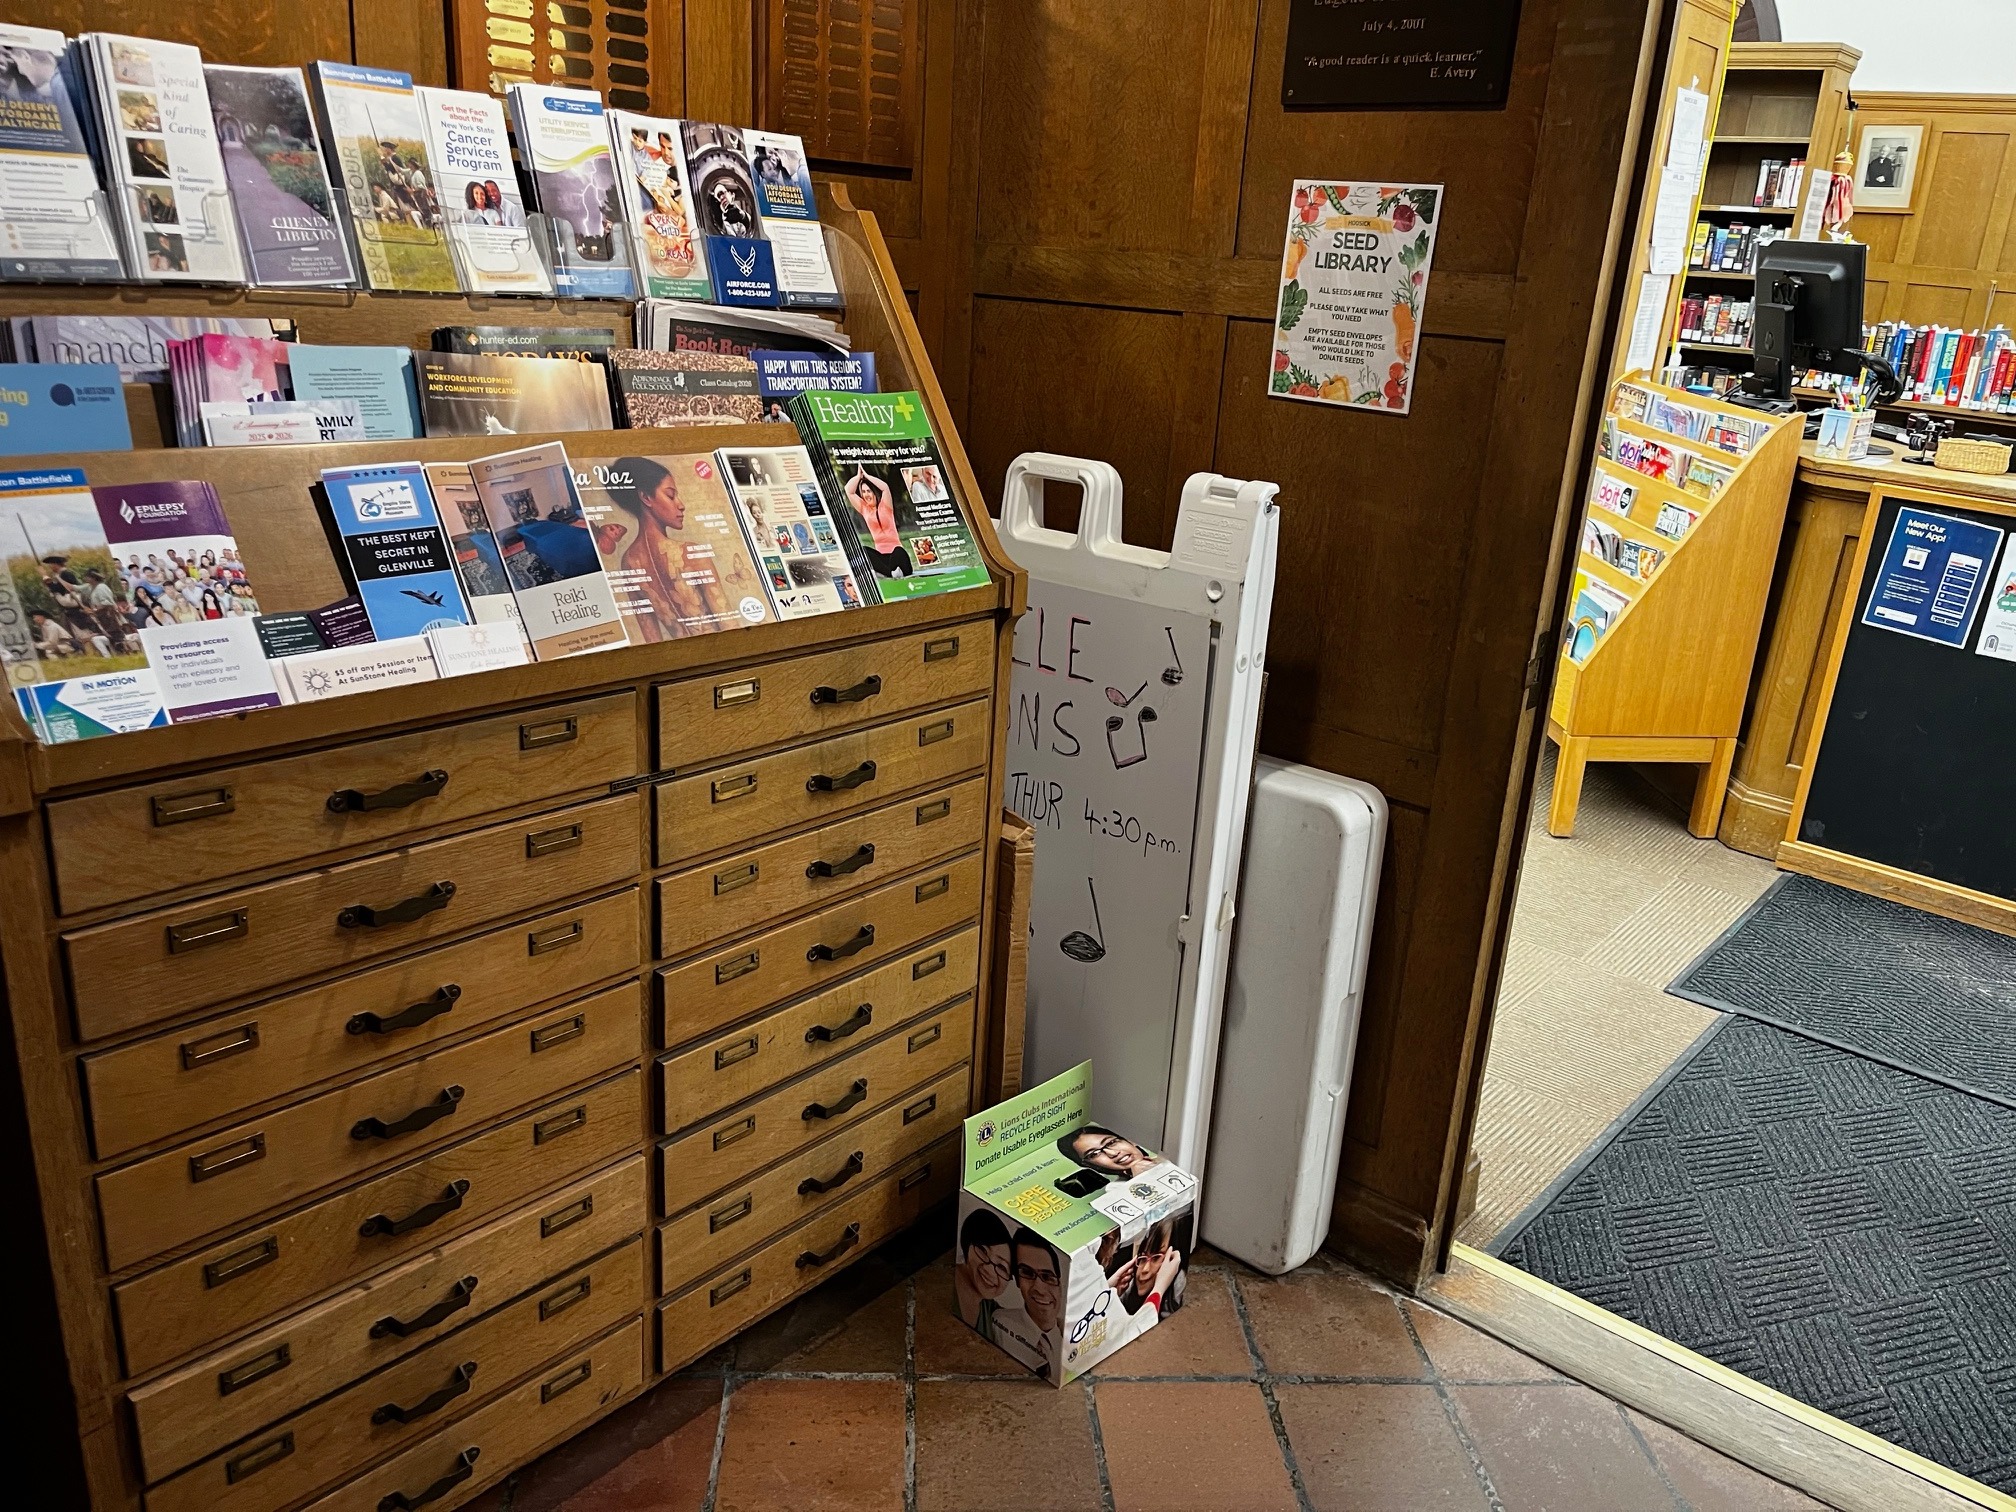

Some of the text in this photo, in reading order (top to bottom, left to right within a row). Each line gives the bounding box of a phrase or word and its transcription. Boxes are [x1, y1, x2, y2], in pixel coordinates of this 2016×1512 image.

[1362, 20, 1383, 33] July
[1400, 18, 1426, 30] 2001
[1319, 52, 1432, 68] good reader is quick
[323, 66, 403, 86] Bennington Battlefield
[1430, 66, 1477, 80] E. Avery
[158, 75, 199, 89] Special
[162, 90, 190, 103] Kind
[165, 105, 178, 120] of
[441, 104, 489, 117] Get the Facts
[449, 113, 483, 124] about the
[169, 122, 207, 138] Caring
[440, 121, 495, 134] New York State
[447, 130, 493, 146] Cancer
[445, 142, 500, 159] Services
[446, 155, 503, 172] Program
[272, 216, 330, 228] CHENEY
[275, 229, 337, 242] LIBRARY
[656, 226, 680, 237] CHILD
[1332, 231, 1379, 251] SEED
[666, 250, 689, 260] READ
[1314, 251, 1393, 274] LIBRARY
[726, 280, 771, 289] AIRFORCE.COM
[1319, 287, 1383, 299] ALL SEEDS ARE FREE
[1310, 303, 1389, 317] PLEASE ONLY TAKE WHAT
[1331, 313, 1362, 323] YOU NEED
[479, 334, 538, 345] hunter-ed.com
[1308, 327, 1383, 341] EMPTY SEED ENVELOPES
[675, 333, 718, 353] Book
[1303, 335, 1386, 351] ARE AVAILABLE FOR THOSE
[1318, 354, 1365, 365] DONATE SEEDS
[1327, 346, 1351, 355] WOULD
[1351, 348, 1365, 356] LIKE
[1366, 349, 1374, 358] TO
[763, 360, 861, 375] HAPPY WITH THIS REGION'S
[426, 373, 514, 385] WORKFORCE DEVELOPMENT
[700, 379, 738, 389] Class Catalog
[767, 376, 862, 391] TRANSPORTATION SYSTEM?
[444, 385, 484, 394] COMMUNITY
[484, 387, 522, 395] EDUCATION
[814, 396, 895, 429] Healthy
[248, 433, 266, 441] 2025
[832, 445, 926, 457] Is weight-loss surgery for you?
[17, 474, 73, 486] Battlefield
[592, 465, 634, 485] Voz
[134, 502, 185, 513] EPILEPSY
[137, 509, 188, 519] FOUNDATION
[1907, 518, 1946, 534] Meet Our
[357, 530, 436, 547] THE BEST KEPT
[1904, 527, 1947, 543] New App!
[375, 545, 430, 560] SECRET IN
[378, 558, 436, 574] GLENVILLE
[554, 586, 588, 605] Reiki
[551, 604, 602, 626] Healing
[160, 636, 230, 653] Providing access
[163, 648, 215, 660] to resources
[166, 656, 224, 671] for individuals
[334, 654, 435, 677] $5 off any Session or Item
[169, 664, 240, 680] with epilepsy and
[338, 665, 418, 685] At SunStone Healing
[82, 676, 137, 691] IN MOTION
[173, 674, 238, 690] their loved ones
[1011, 772, 1182, 857] THUR 4:30 p.m.
[1000, 1080, 1086, 1130] Lions Clubs International
[1000, 1101, 1067, 1142] RECYCLE FOR SIGHT
[975, 1108, 1083, 1171] Donate Usable Eyeglasses Here
[986, 1168, 1037, 1196] Help child read
[1004, 1184, 1045, 1209] CARE
[1019, 1189, 1058, 1218] GIVE
[1031, 1197, 1073, 1225] RECYCLE
